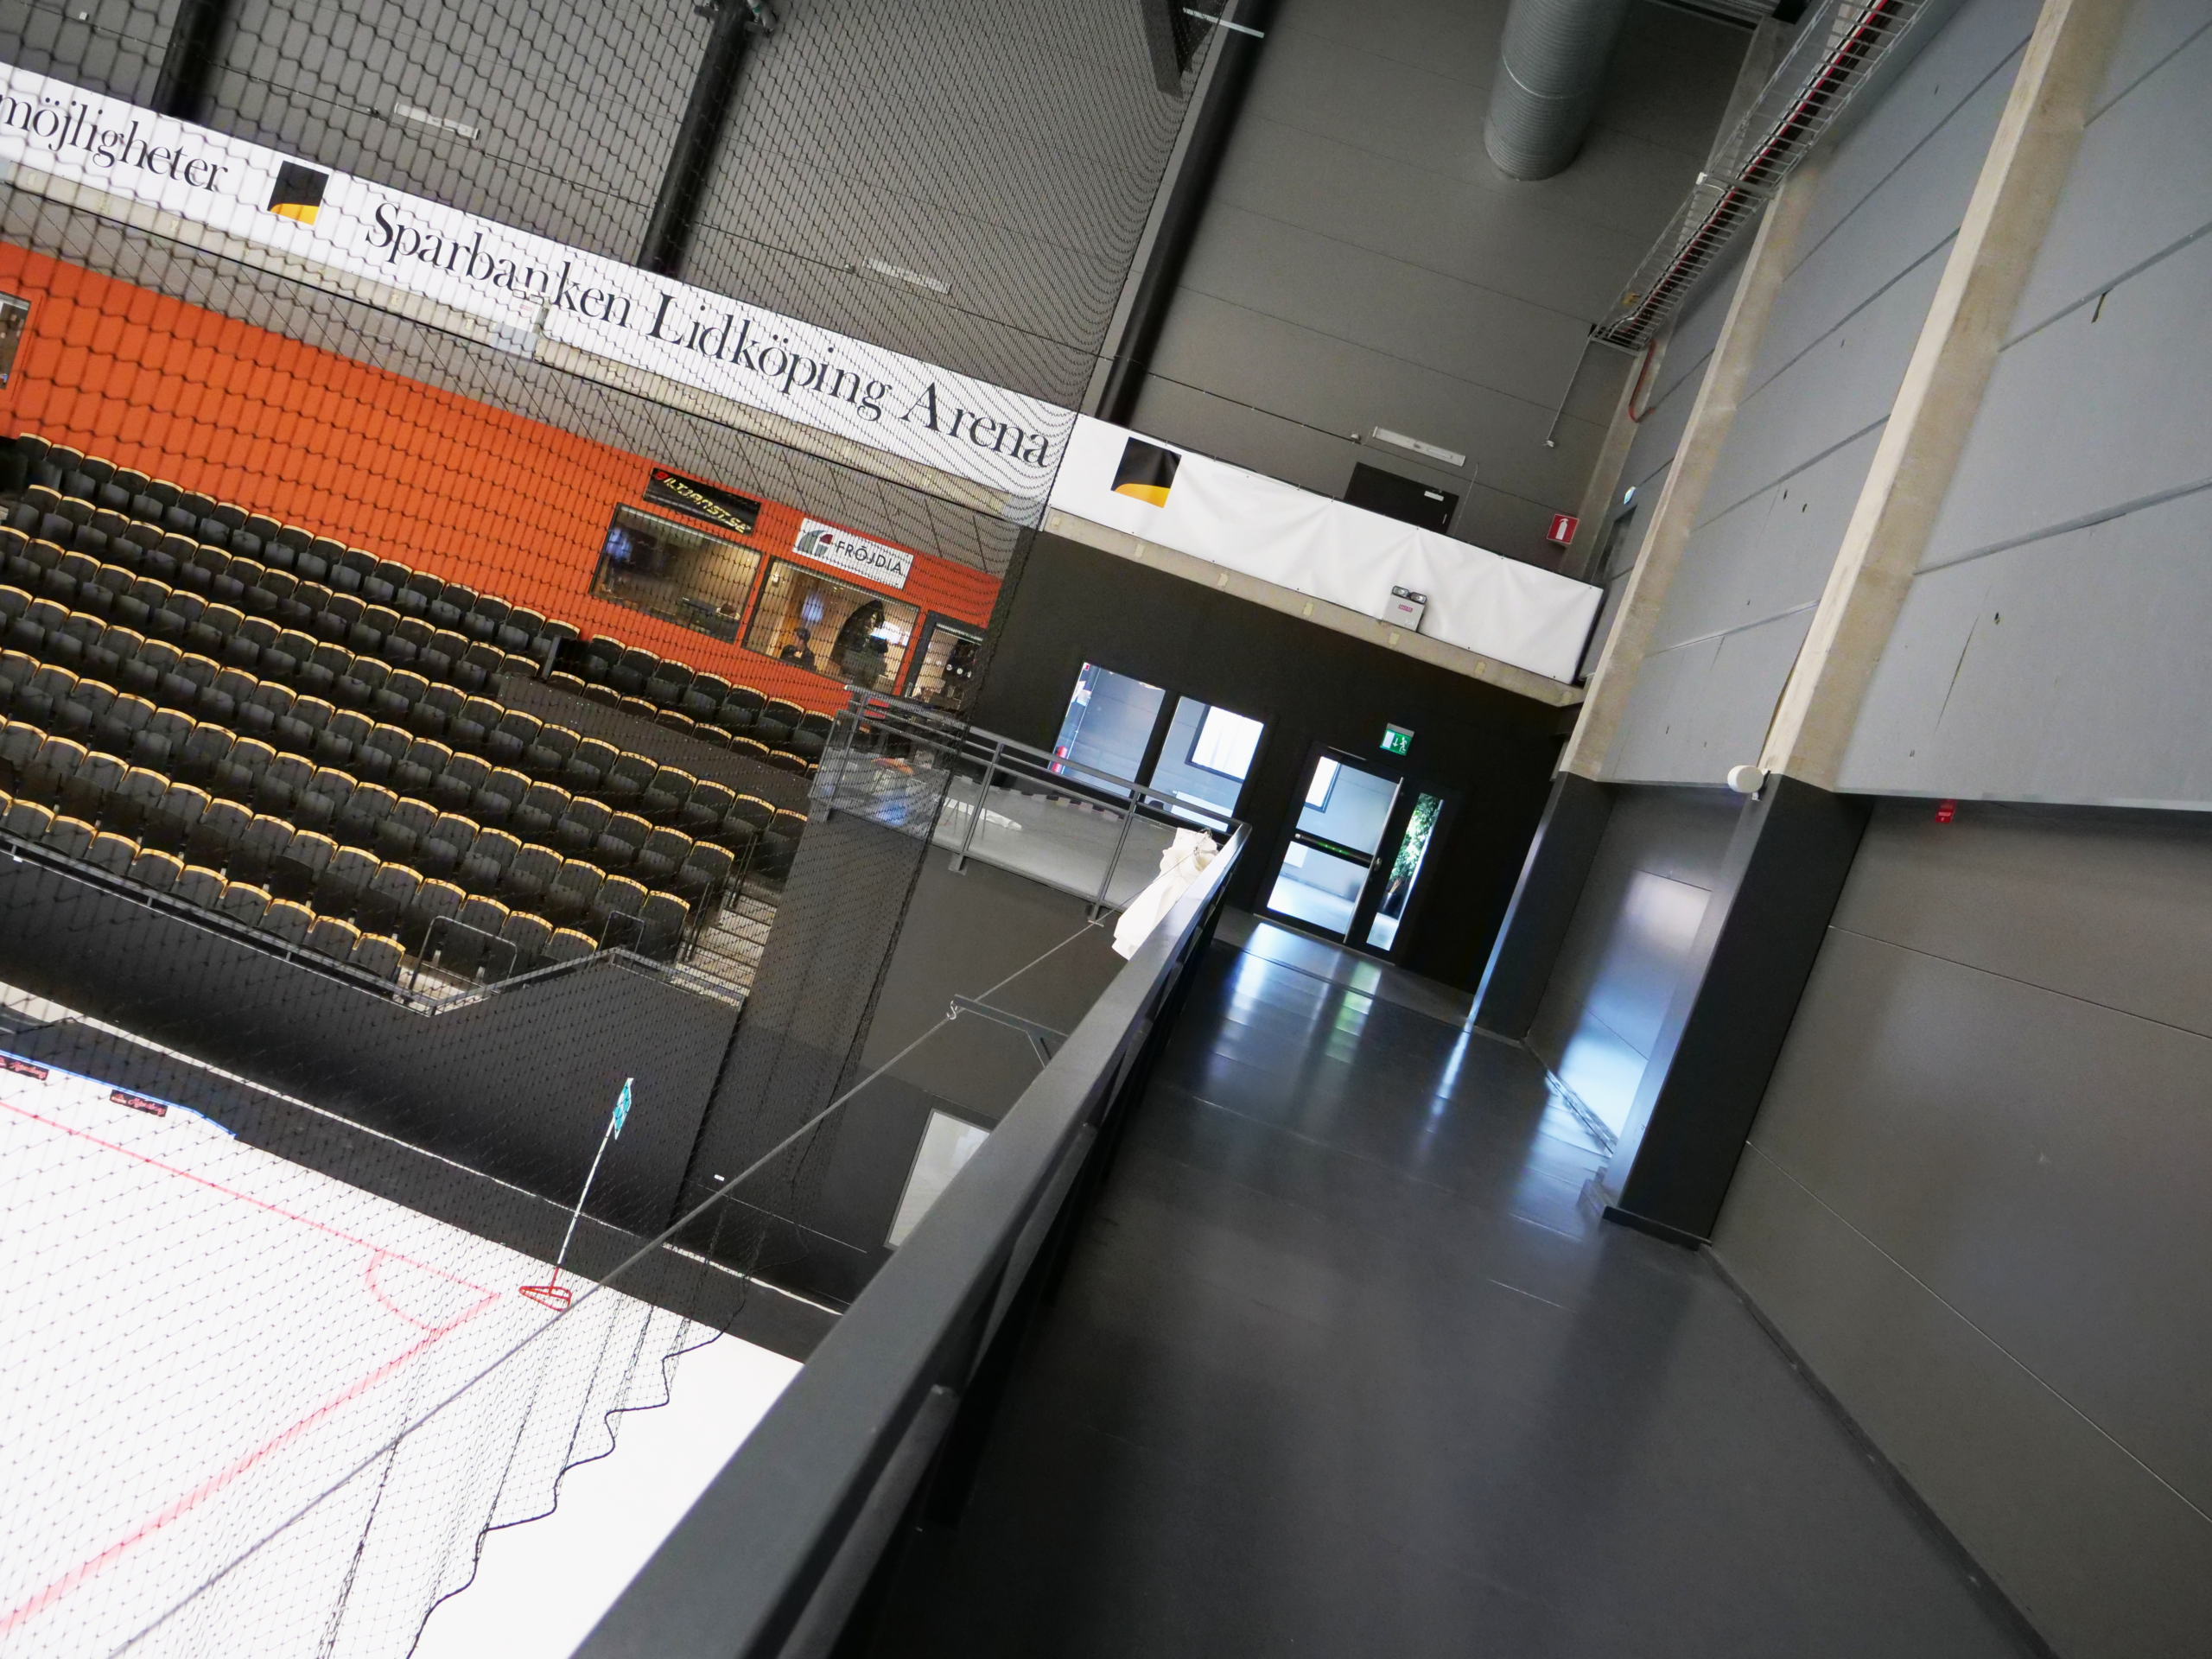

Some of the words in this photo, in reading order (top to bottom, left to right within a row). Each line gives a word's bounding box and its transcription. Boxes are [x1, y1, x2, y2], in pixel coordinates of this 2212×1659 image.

[365, 202, 632, 328] Sparbanken
[647, 291, 893, 422] Lidköping
[899, 381, 1047, 468] Arena
